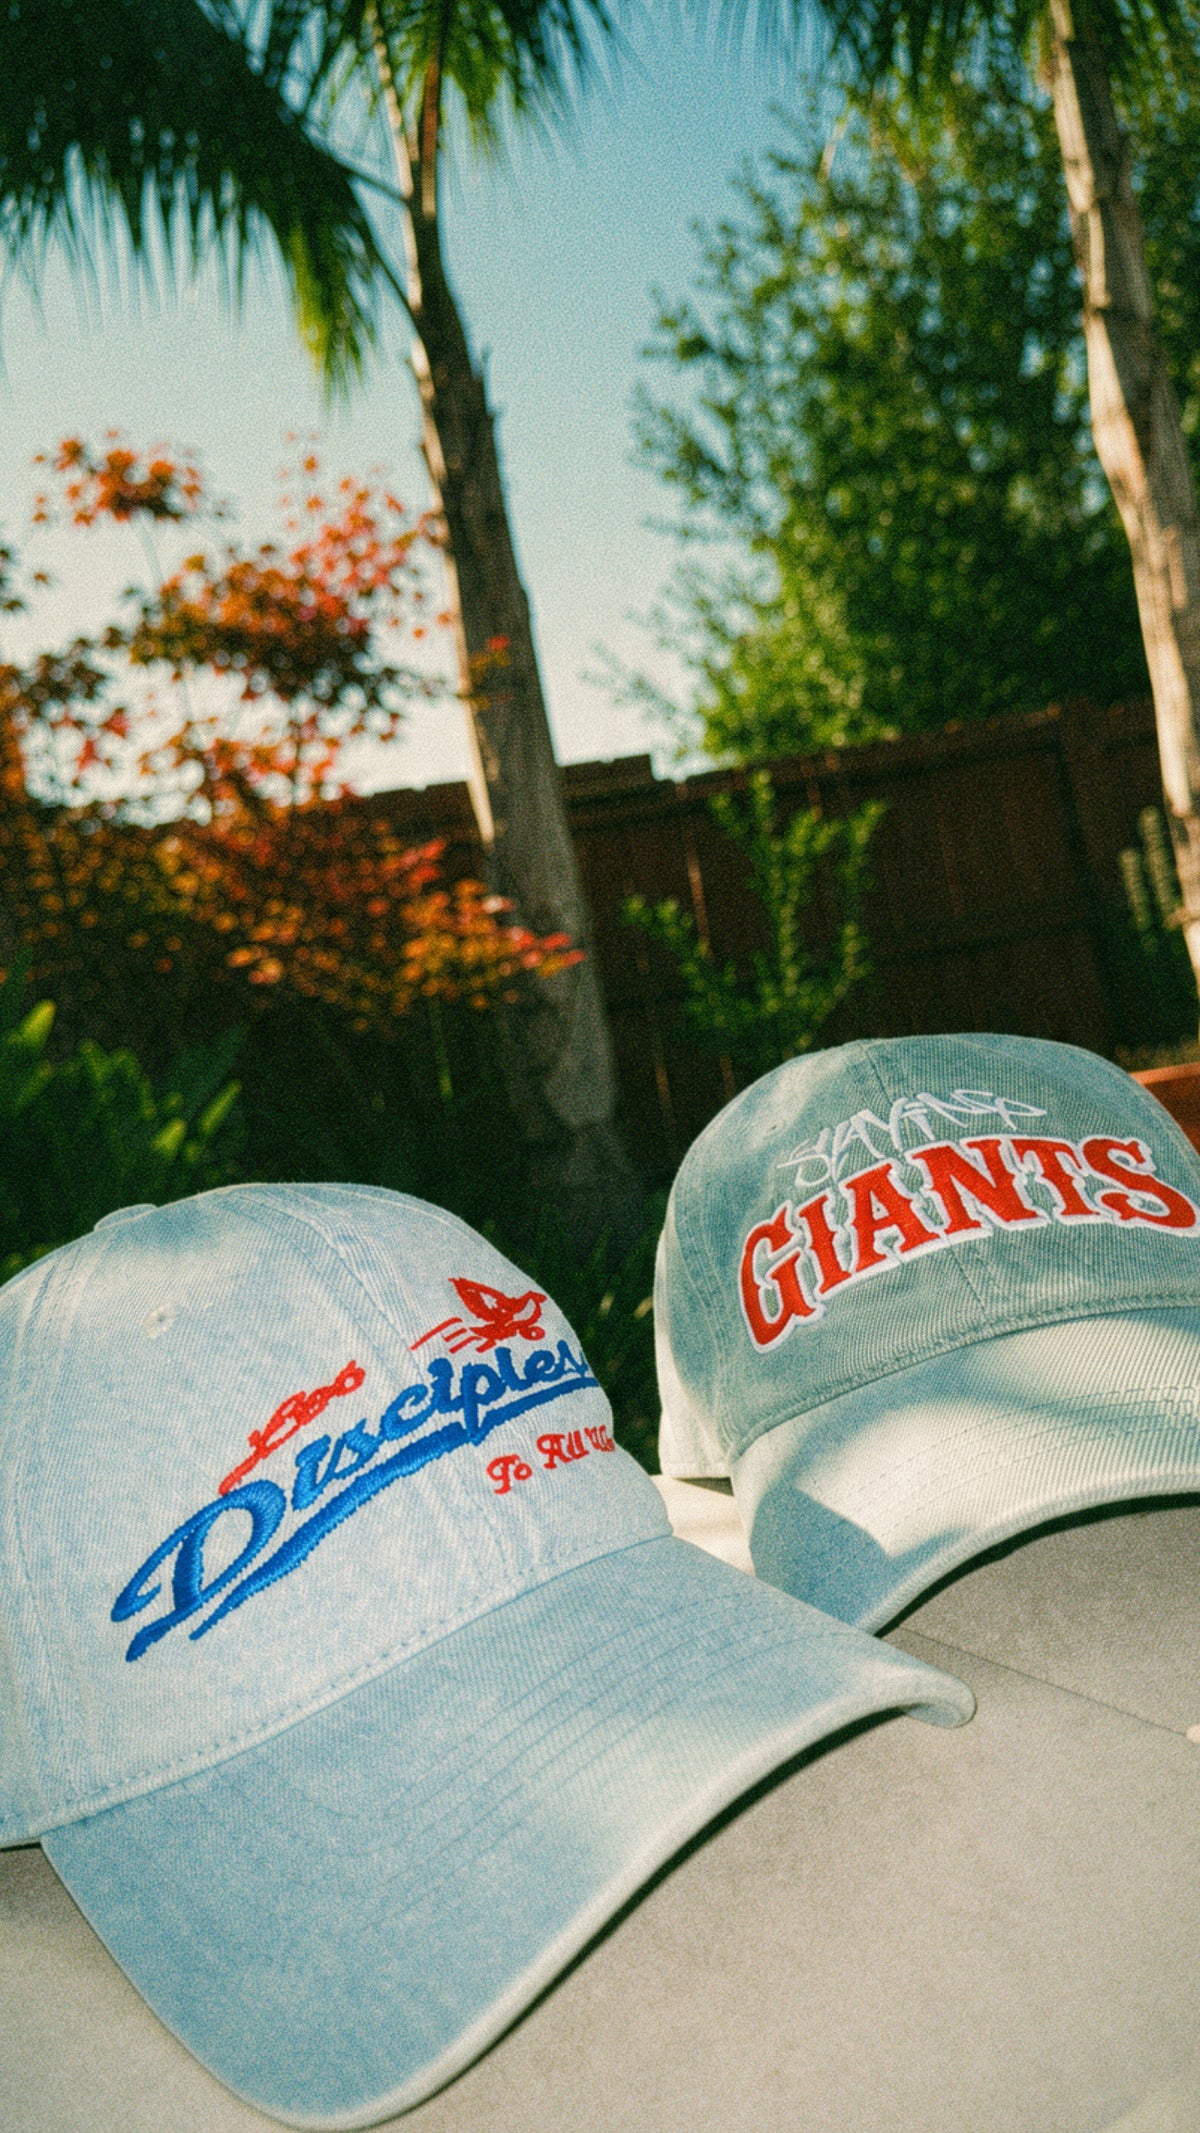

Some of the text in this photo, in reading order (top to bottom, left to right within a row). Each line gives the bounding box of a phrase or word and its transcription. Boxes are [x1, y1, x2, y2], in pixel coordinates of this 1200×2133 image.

[740, 1134, 1200, 1353] GIANTS
[110, 1339, 590, 1663] Disciples
[486, 1453, 533, 1495] To
[536, 1430, 590, 1470] All
